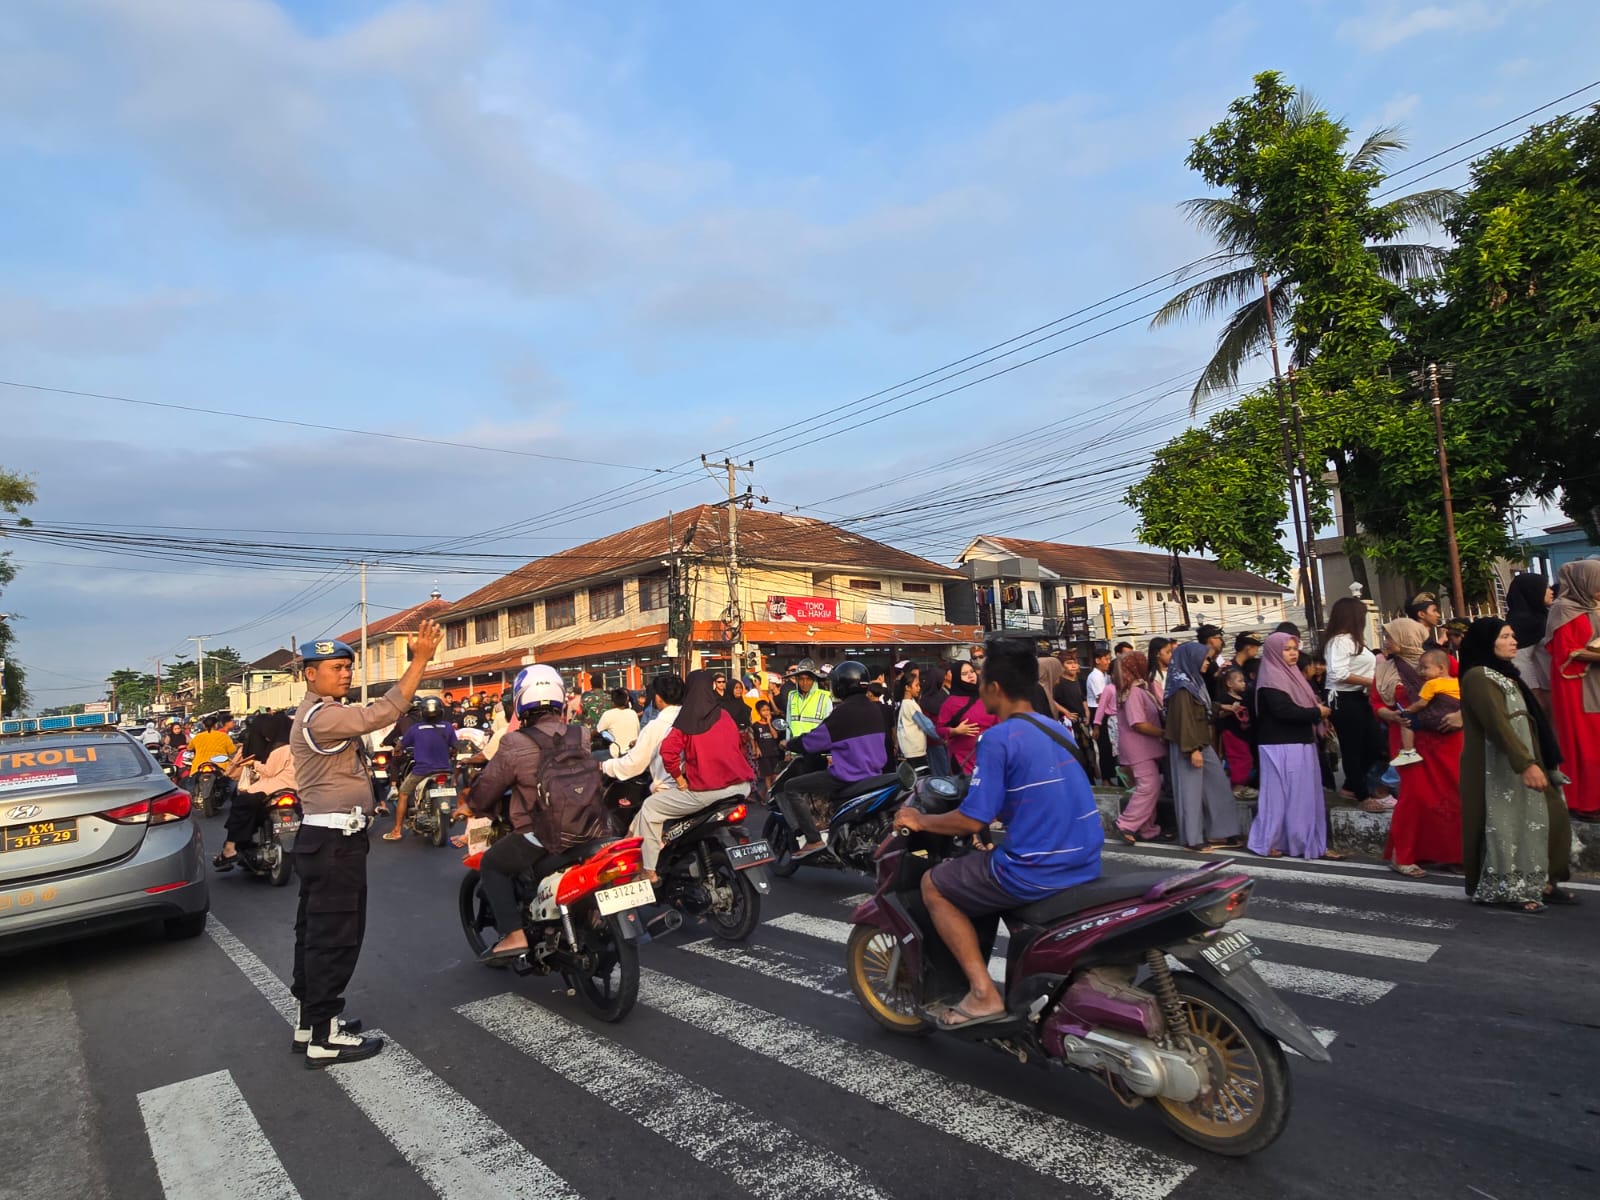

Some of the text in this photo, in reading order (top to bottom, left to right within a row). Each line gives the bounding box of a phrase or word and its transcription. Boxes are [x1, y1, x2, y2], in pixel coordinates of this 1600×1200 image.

[804, 602, 825, 610] TOKO
[797, 609, 807, 618] EL
[597, 892, 609, 903] DR
[614, 885, 635, 898] 3122
[1202, 946, 1222, 962] DR
